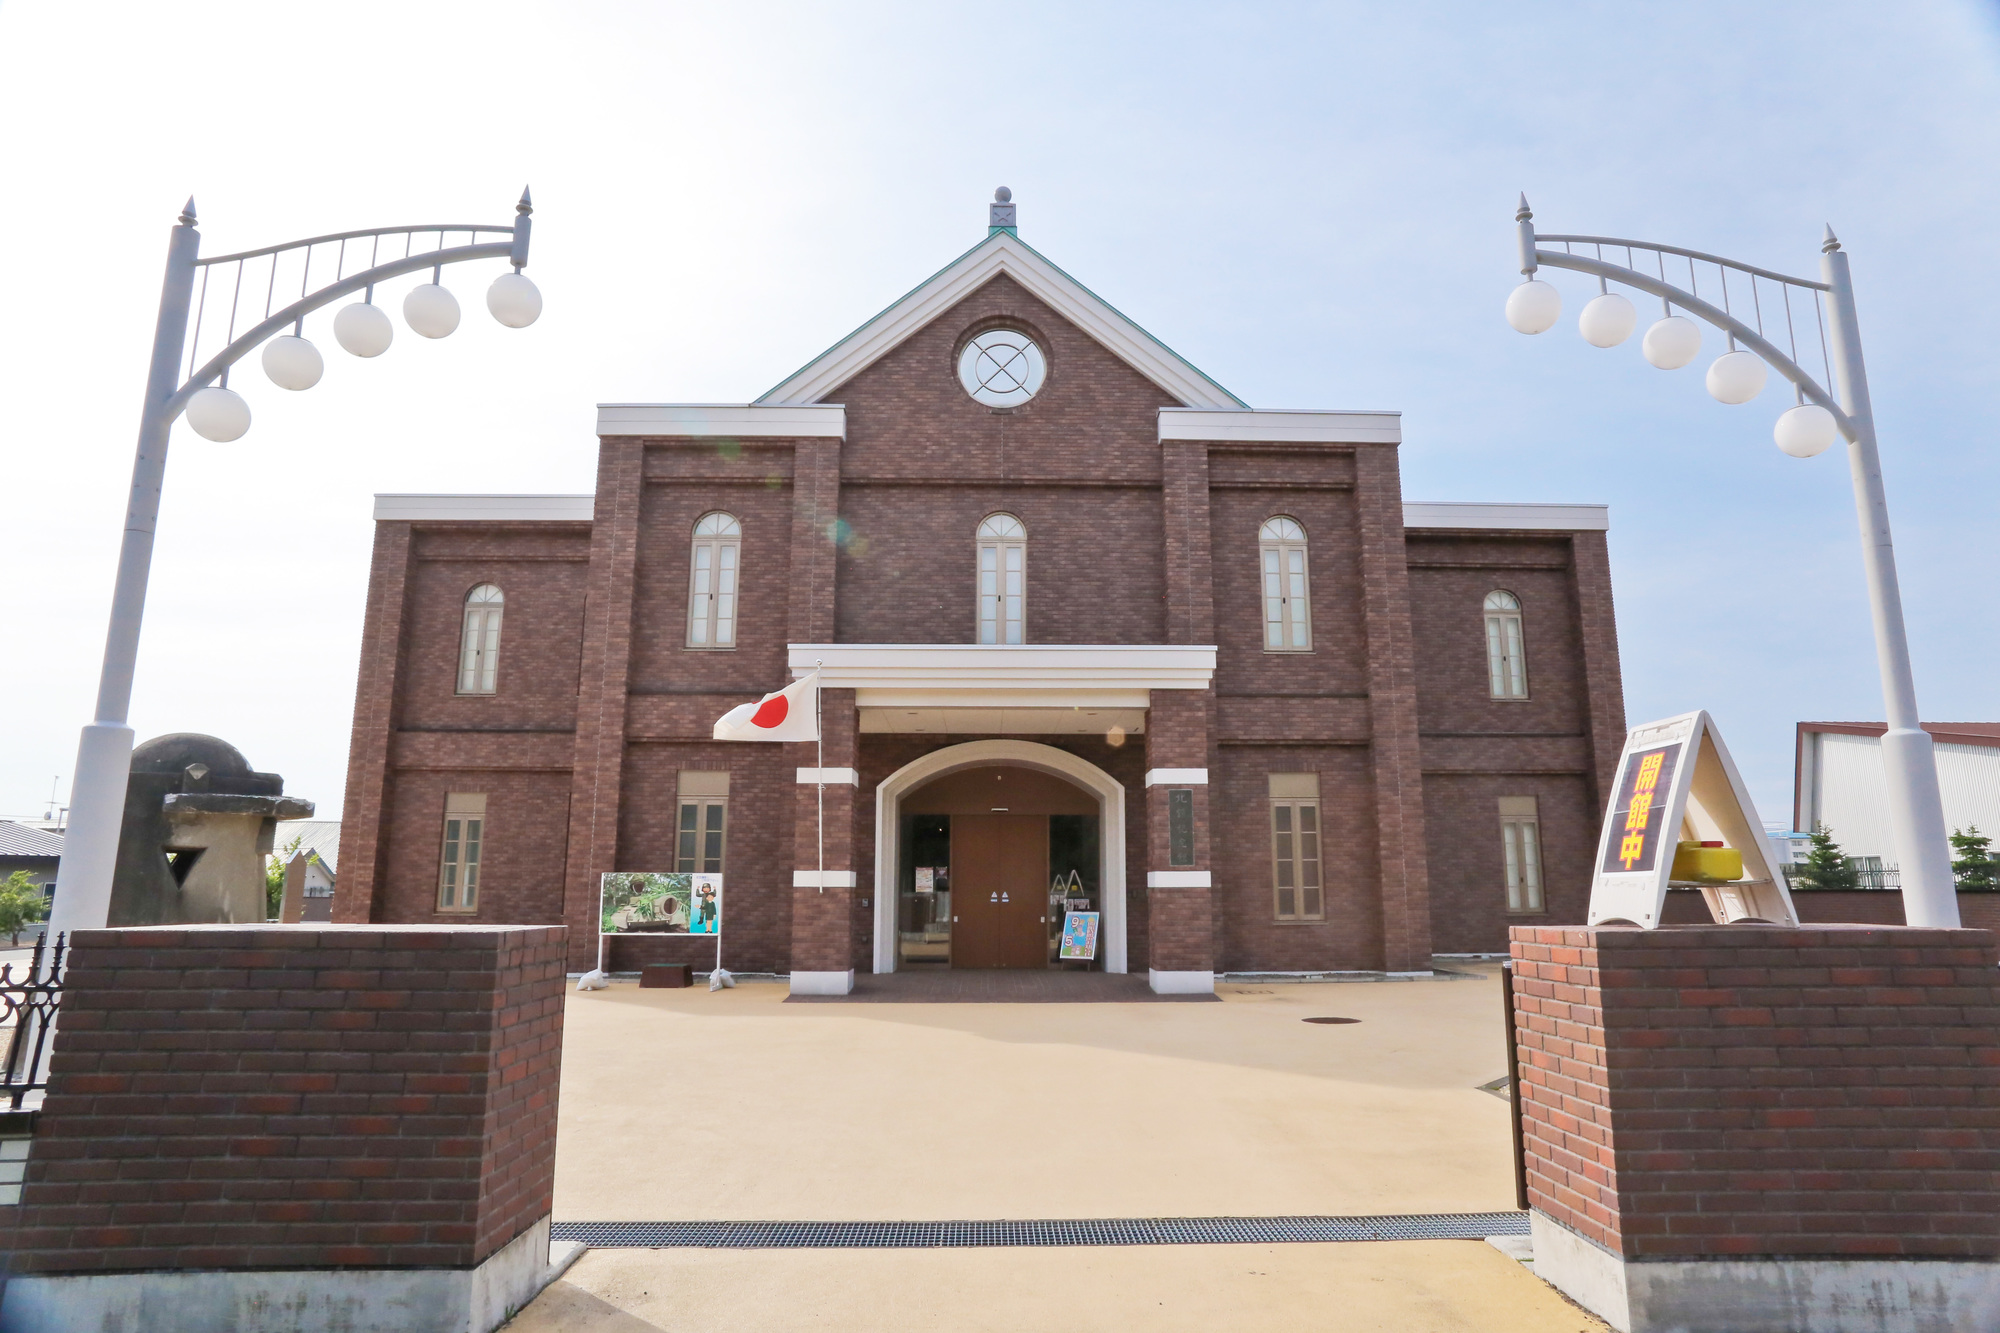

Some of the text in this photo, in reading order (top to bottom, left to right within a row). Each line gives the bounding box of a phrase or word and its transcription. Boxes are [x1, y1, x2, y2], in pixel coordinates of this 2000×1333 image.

[1619, 752, 1665, 870] 開館中
[1071, 916, 1080, 928] 9
[1064, 934, 1074, 947] 5
